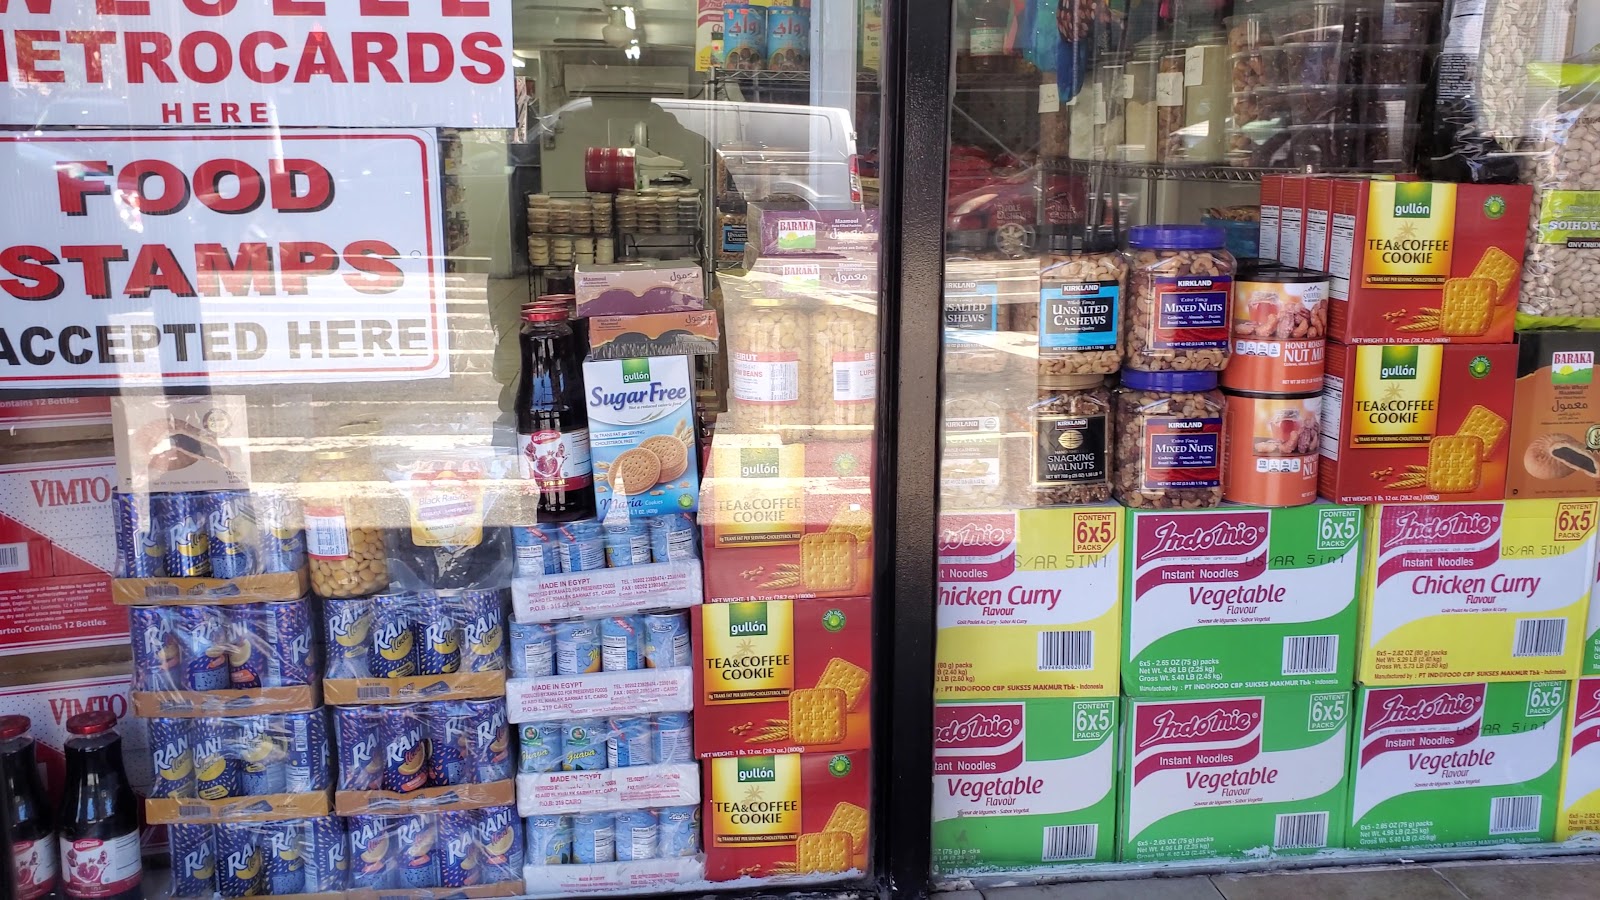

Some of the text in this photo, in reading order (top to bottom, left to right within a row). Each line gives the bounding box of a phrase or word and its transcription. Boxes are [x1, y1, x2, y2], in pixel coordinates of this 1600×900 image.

[0, 30, 506, 84] ETROCARDS
[161, 102, 269, 123] HERE
[56, 158, 335, 216] FOOD
[1395, 202, 1430, 216] gullón
[780, 222, 814, 231] BARAKA
[1368, 239, 1449, 251] TEA&COFFEE
[1382, 252, 1433, 264] COOKIE
[0, 240, 406, 301] STAMPS
[784, 267, 818, 276] BARAKA
[1052, 305, 1108, 315] UNSALTED
[1165, 303, 1222, 313] MIXED NUTS
[1054, 315, 1106, 326] CASHEWS
[288, 319, 429, 359] HERE
[1284, 349, 1310, 362] NUT
[1554, 353, 1592, 364] BARAKA
[624, 371, 649, 382] gullón
[1382, 364, 1415, 378] gullón
[1355, 400, 1434, 412] TEA&COFFEE
[1551, 400, 1588, 413] معمول
[1369, 412, 1418, 424] COOKIE
[1155, 444, 1213, 453] MIXED NUTS
[1048, 453, 1095, 462] SNACKING
[742, 462, 778, 477] gullón
[1048, 461, 1095, 471] WALNUTS
[30, 477, 110, 507] VIMTO
[717, 498, 800, 511] TEA&COFFEE
[733, 510, 785, 523] COOKIE
[1558, 511, 1590, 531] 6x5
[1077, 522, 1111, 544] 6x5
[1321, 518, 1355, 540] 6x5
[1403, 557, 1474, 567] Instant Noodles
[950, 569, 988, 578] Noodles
[1162, 569, 1239, 579] Instant Noodles
[1412, 574, 1541, 598] Chicken Curry
[940, 586, 1061, 610] hicken Curry
[1189, 584, 1286, 611] Vegetable
[1466, 595, 1496, 605] Flavour
[982, 607, 1014, 616] Flavour
[1226, 605, 1258, 615] Flavour
[24, 623, 62, 632] Contains
[77, 619, 106, 627] Bottles
[731, 620, 766, 635] gullón
[706, 655, 790, 669] TEA&COFFEE
[1200, 658, 1219, 666] packs
[722, 668, 775, 680] COOKIE
[1530, 687, 1561, 707] 6x5
[1312, 701, 1344, 722] 6x5
[1077, 709, 1109, 731] 6x5
[387, 725, 423, 767] RANI
[1385, 736, 1455, 748] Instant Noodles
[958, 761, 996, 770] Noodles
[1159, 754, 1233, 766] Instant Noodles
[1408, 749, 1496, 775] Vegetable
[739, 766, 774, 781] gullón
[1441, 769, 1469, 778] Flavour
[1186, 767, 1278, 793] Vegetable
[947, 776, 1044, 802] Vegetable
[1222, 787, 1251, 797] Flavour
[715, 801, 797, 813] TEA&COFFEE
[985, 797, 1016, 806] Flavour
[731, 813, 782, 824] COOKIE
